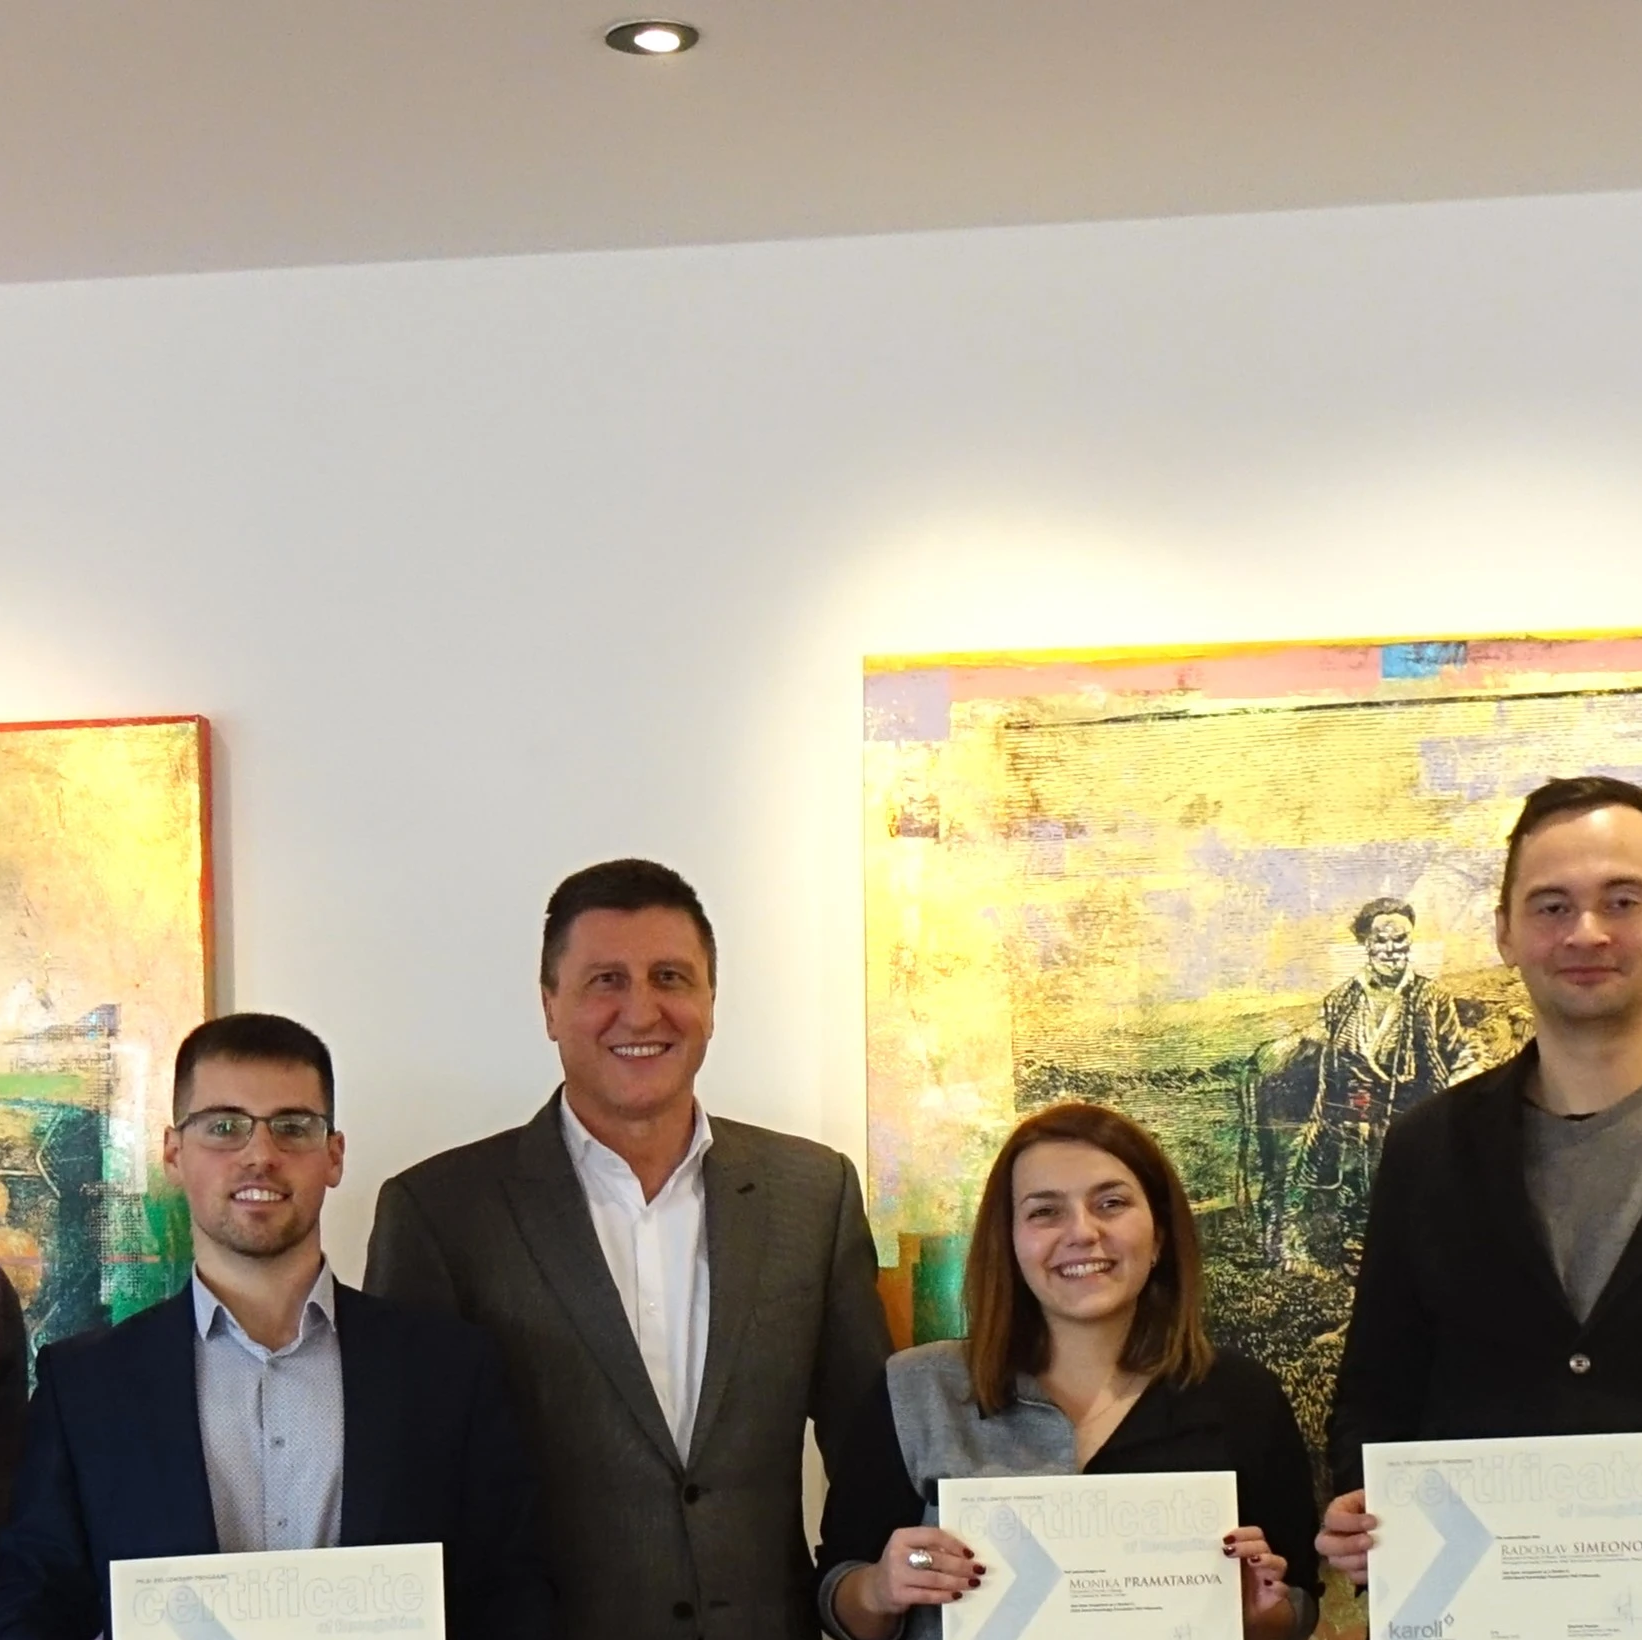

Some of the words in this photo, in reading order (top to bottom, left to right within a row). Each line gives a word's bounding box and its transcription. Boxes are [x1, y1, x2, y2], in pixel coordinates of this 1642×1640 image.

[958, 1489, 1221, 1541] certificate
[133, 1563, 425, 1627] certificate
[1124, 1573, 1223, 1588] PRAMATAROVA
[1388, 1621, 1443, 1640] karoll
